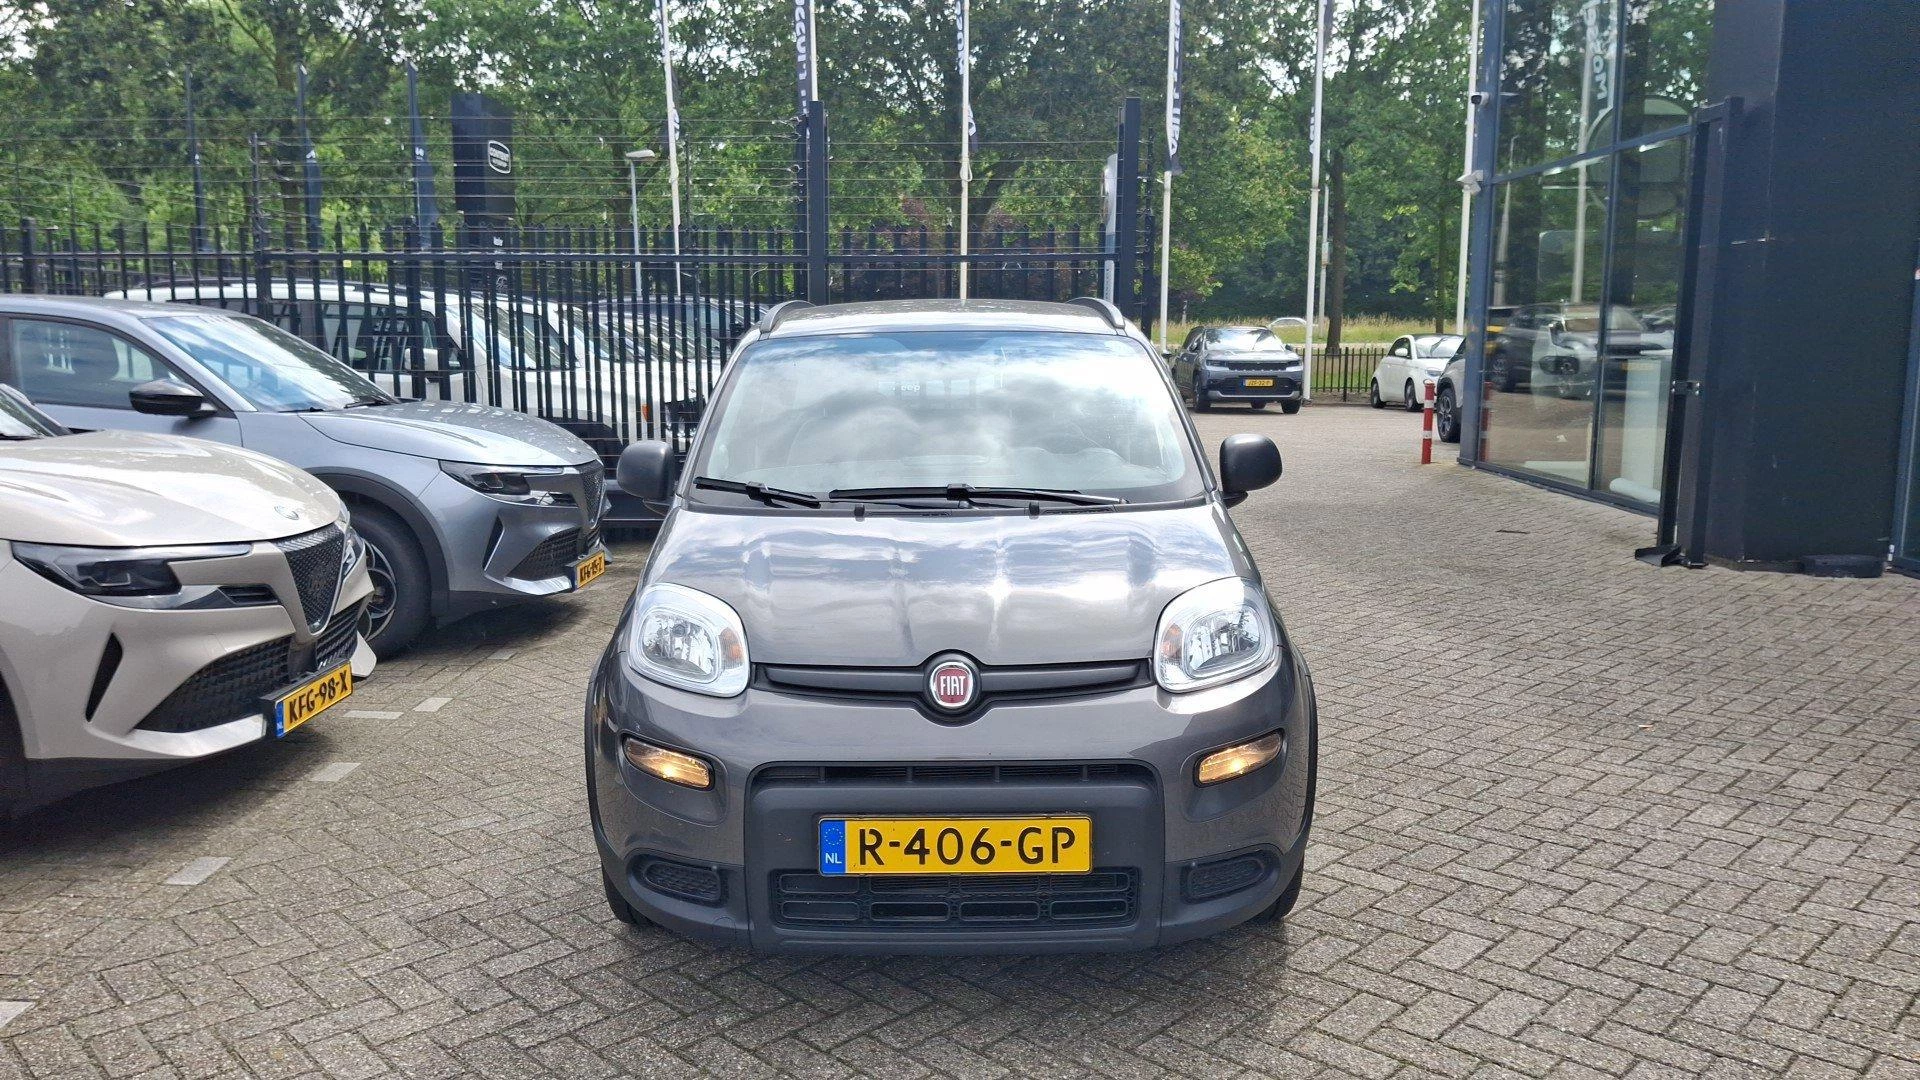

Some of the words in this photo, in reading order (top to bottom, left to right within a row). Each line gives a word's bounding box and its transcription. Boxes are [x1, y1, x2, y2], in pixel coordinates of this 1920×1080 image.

[289, 669, 348, 723] KFG-98-X
[940, 675, 966, 696] FIAT
[825, 852, 843, 865] NL
[858, 826, 1076, 866] R-406-GP
